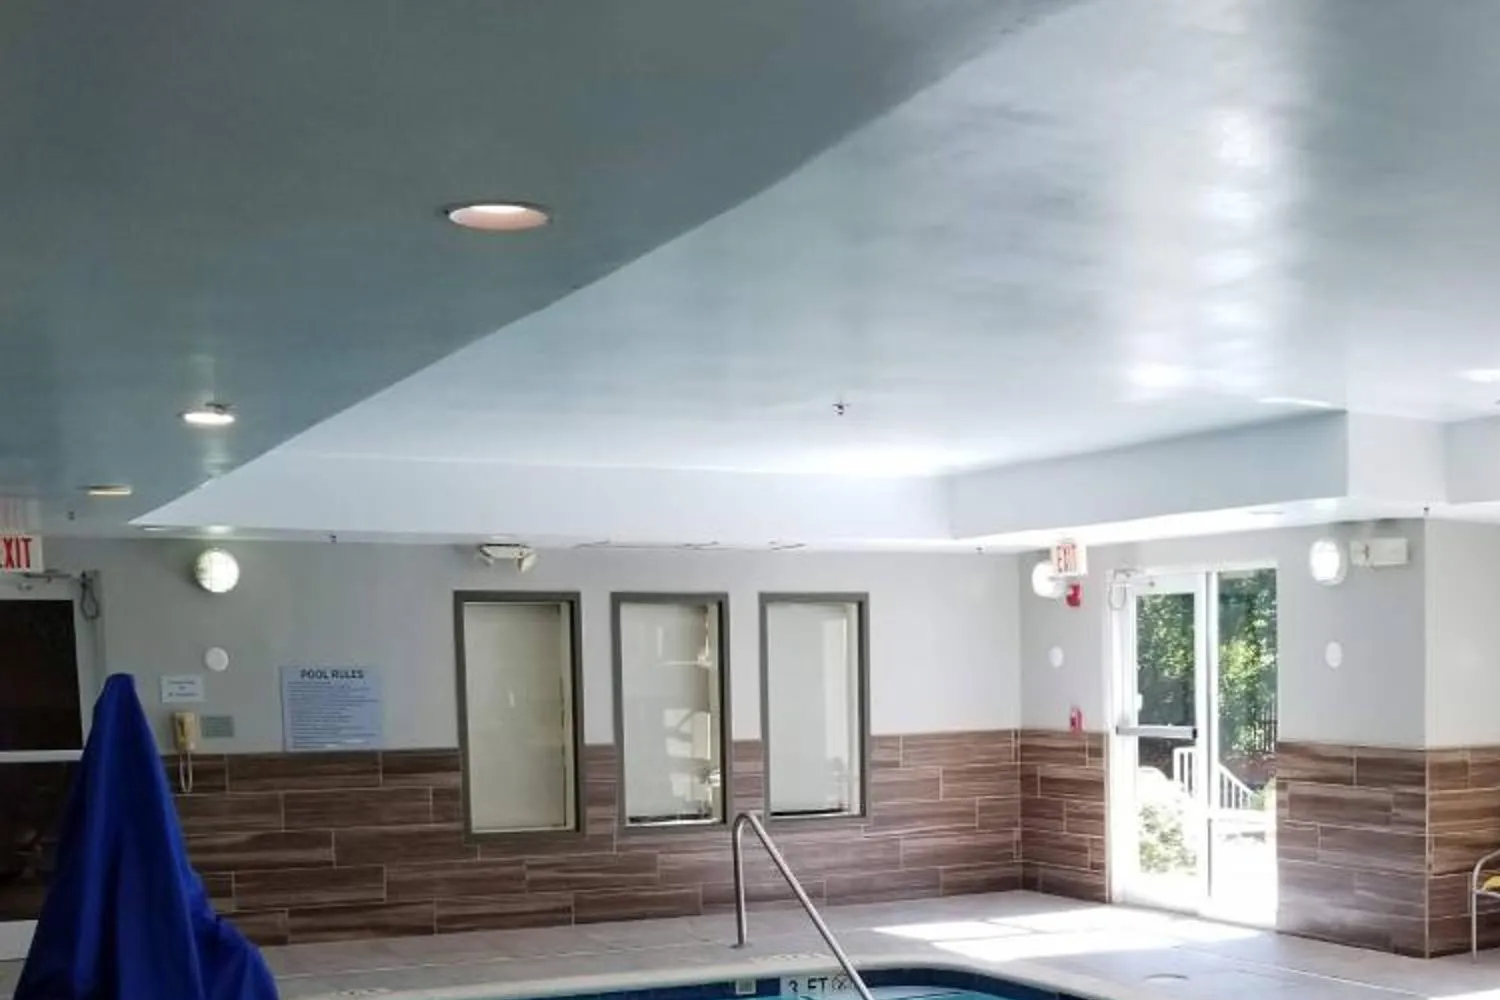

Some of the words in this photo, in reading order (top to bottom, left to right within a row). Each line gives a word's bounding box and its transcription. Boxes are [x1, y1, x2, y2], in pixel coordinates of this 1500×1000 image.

[0, 537, 32, 569] XIT
[1056, 544, 1077, 573] EXIT
[300, 668, 329, 680] POOL
[331, 668, 365, 680] RULES
